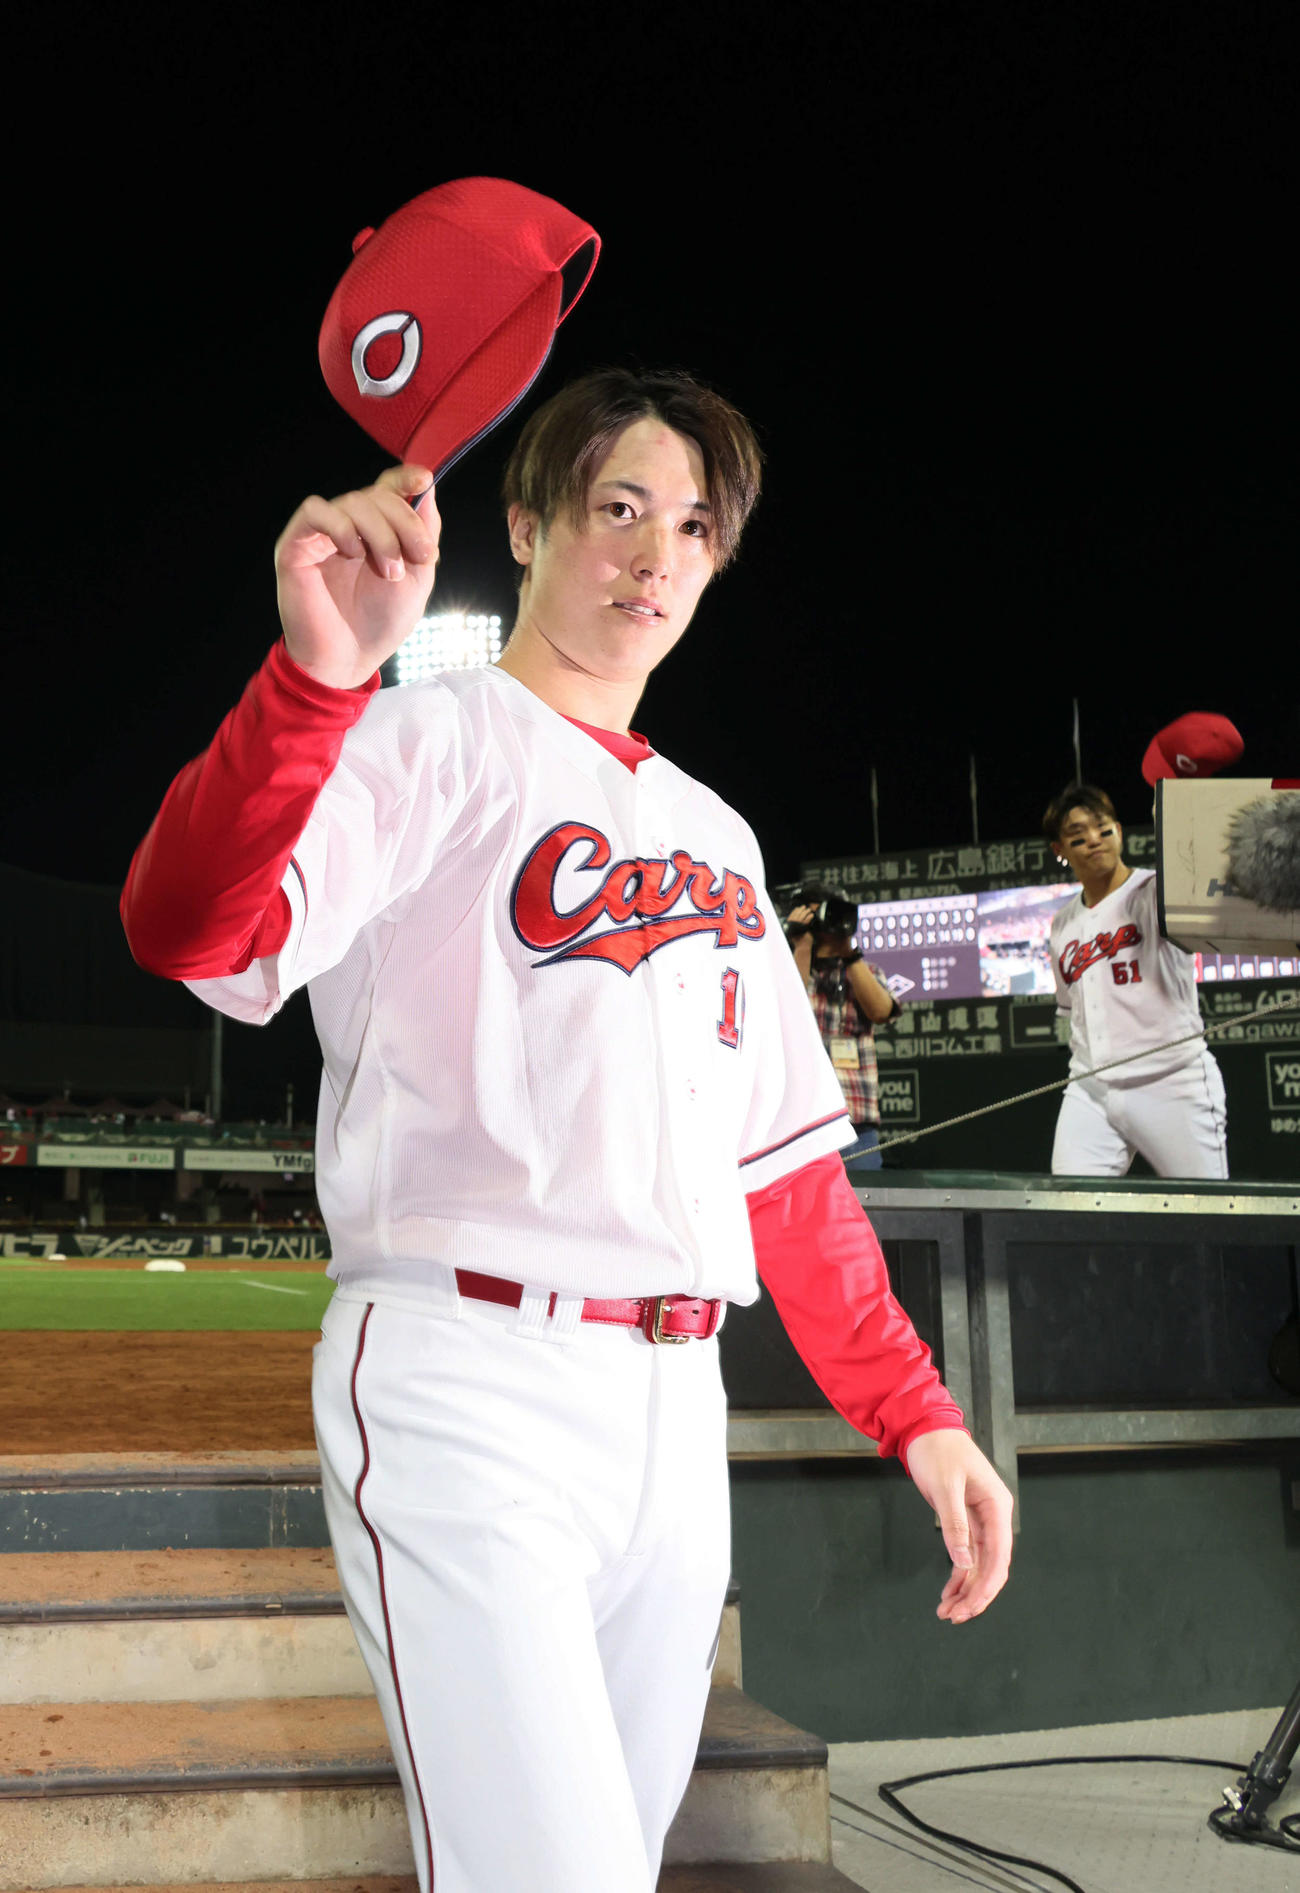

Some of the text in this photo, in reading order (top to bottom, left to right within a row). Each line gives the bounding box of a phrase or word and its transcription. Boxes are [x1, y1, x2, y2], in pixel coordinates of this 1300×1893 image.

[927, 841, 1050, 881] 広島銀行
[509, 821, 766, 977] Carp
[1058, 924, 1143, 989] Carp
[1111, 960, 1143, 985] 51
[716, 966, 746, 1055] 1
[1256, 989, 1300, 1014] ムロ
[1274, 1063, 1300, 1085] yo
[881, 1097, 913, 1112] me
[0, 1233, 59, 1258] ヒラ
